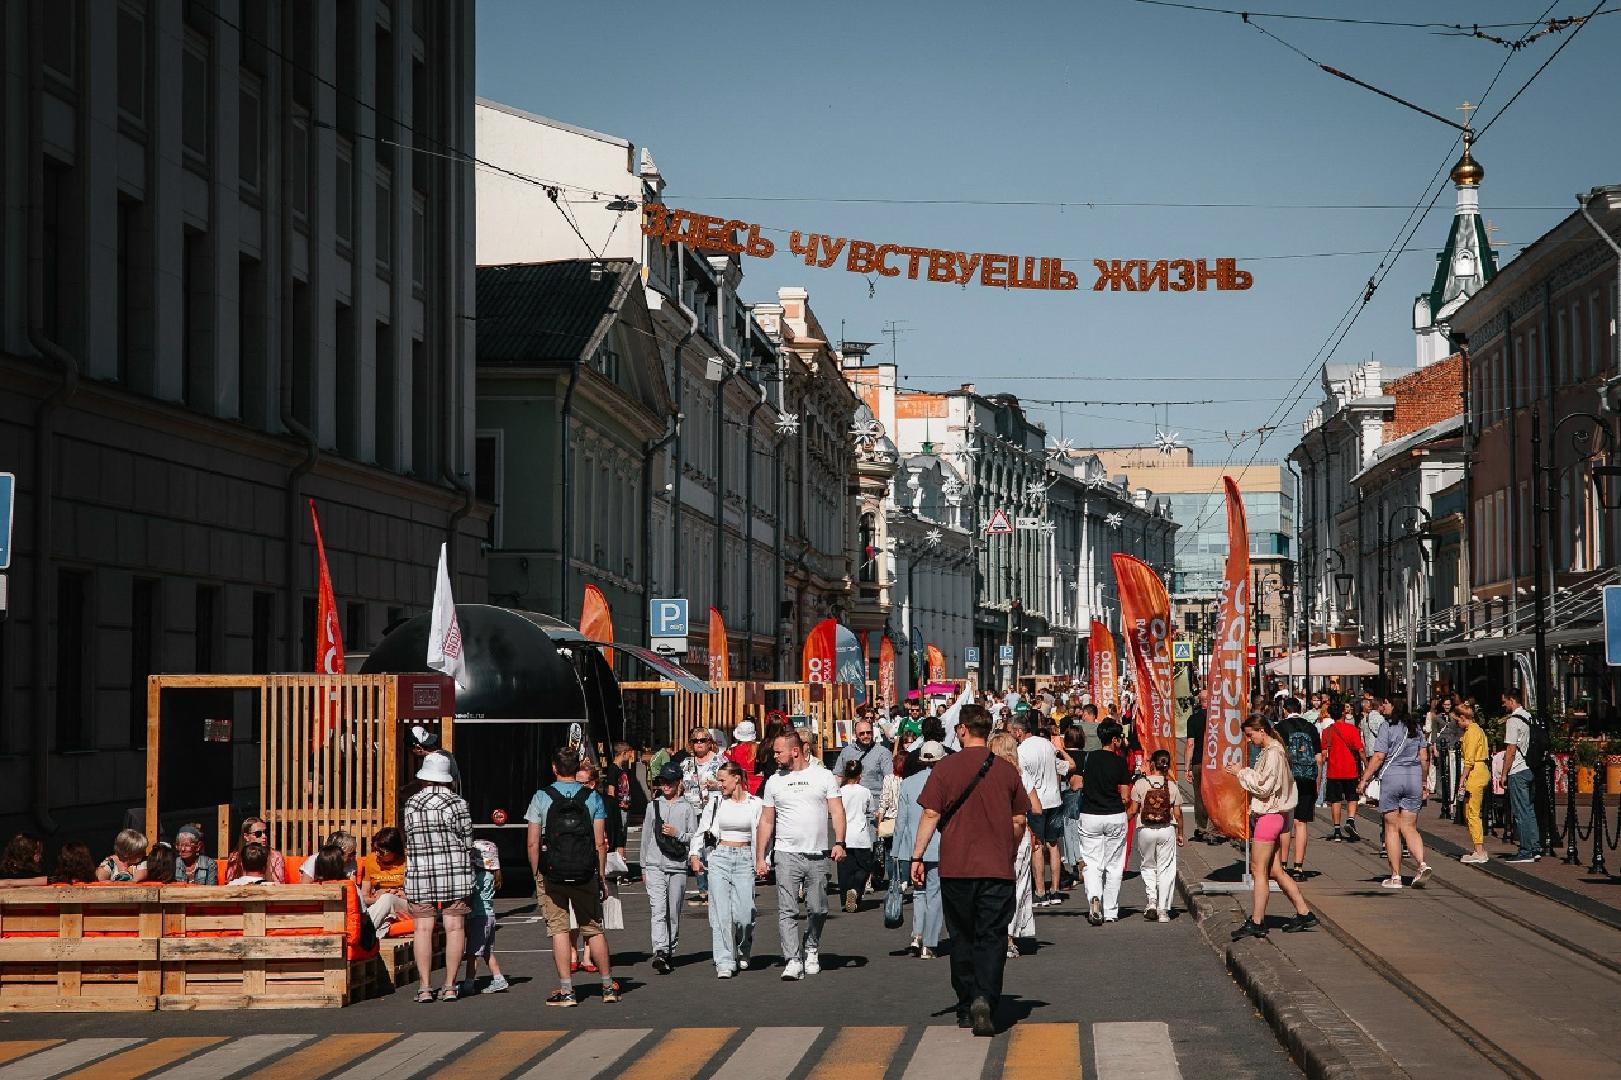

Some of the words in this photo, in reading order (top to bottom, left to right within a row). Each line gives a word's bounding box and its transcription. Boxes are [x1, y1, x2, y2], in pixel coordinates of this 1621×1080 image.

[641, 203, 775, 258] ЗДЕСЬ
[790, 229, 1079, 290] ЧУВСТВУЕШЬ
[1093, 257, 1254, 291] ЖИЗНЬ
[661, 603, 680, 632] P
